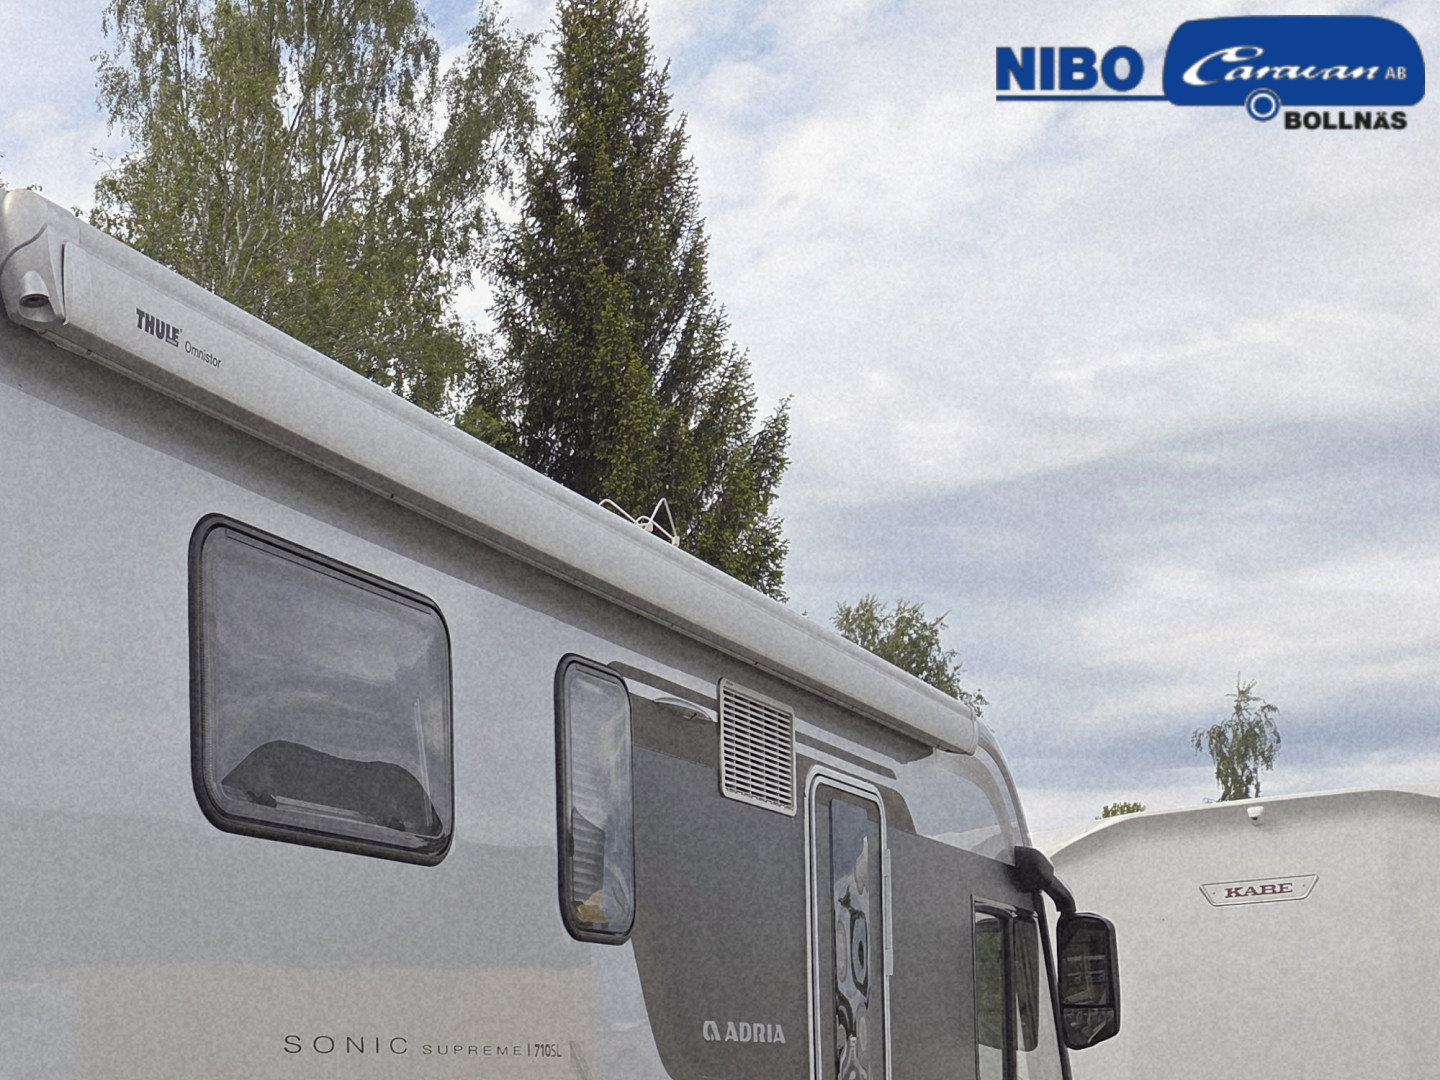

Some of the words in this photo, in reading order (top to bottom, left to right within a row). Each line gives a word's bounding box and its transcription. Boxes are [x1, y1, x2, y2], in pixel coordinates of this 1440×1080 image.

[135, 307, 181, 349] THULE
[184, 340, 222, 369] Omnistor
[1224, 882, 1294, 899] KABE
[724, 1021, 787, 1044] ADRIA
[283, 1034, 408, 1055] SONIC
[422, 1044, 523, 1056] SUPREME
